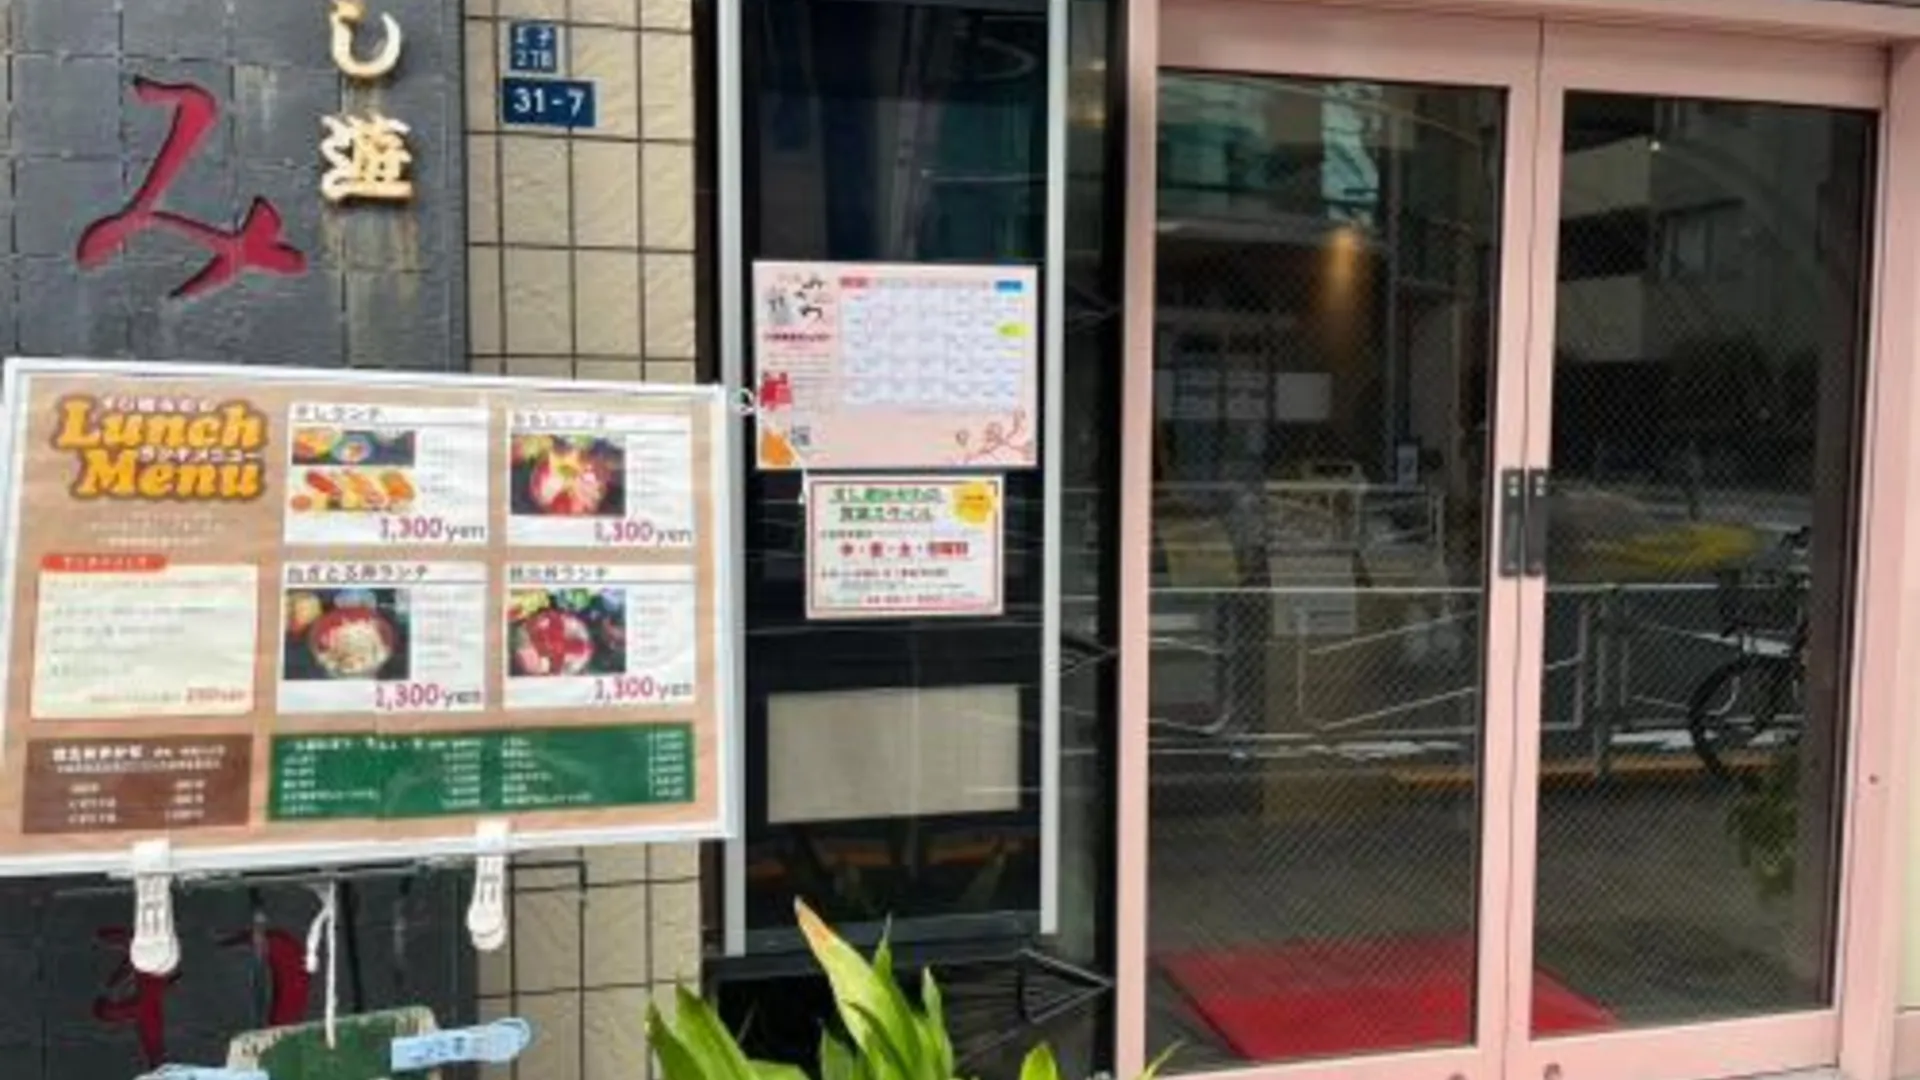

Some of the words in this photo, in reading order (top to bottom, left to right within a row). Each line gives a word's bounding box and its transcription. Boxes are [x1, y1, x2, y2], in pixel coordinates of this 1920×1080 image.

[514, 87, 584, 117] 31-7
[57, 398, 264, 447] Lunch
[77, 449, 260, 497] Menu
